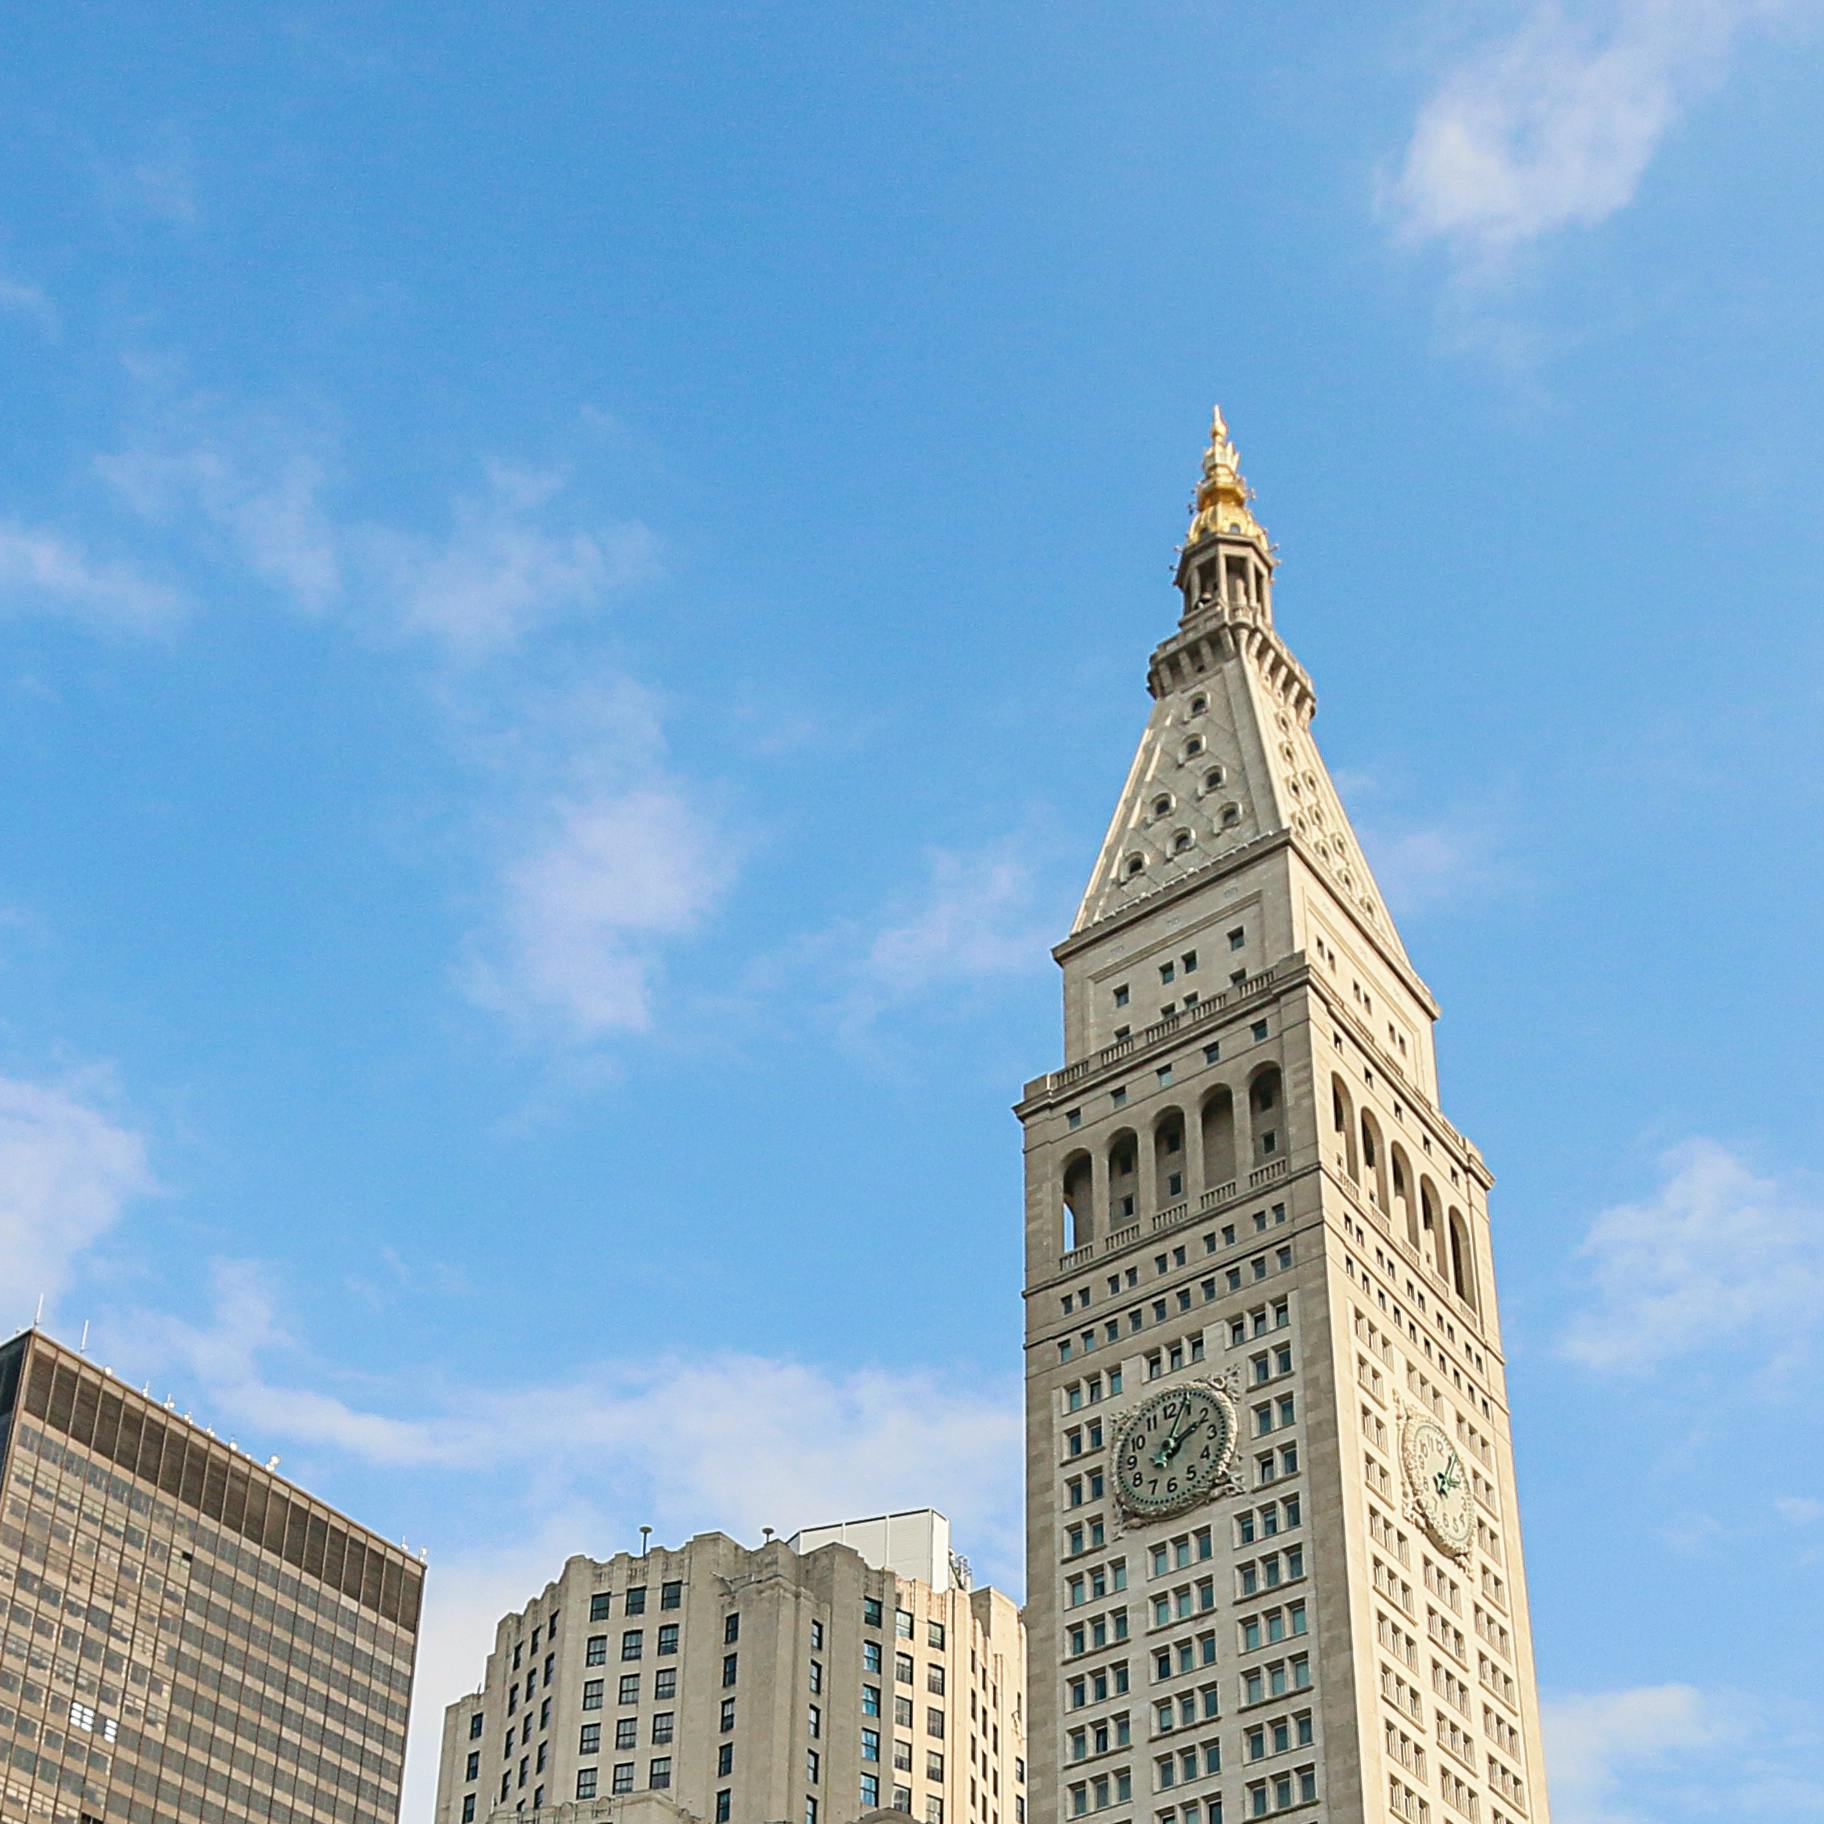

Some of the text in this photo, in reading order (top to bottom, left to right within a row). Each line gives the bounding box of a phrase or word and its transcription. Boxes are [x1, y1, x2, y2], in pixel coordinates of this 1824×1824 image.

[1163, 1402, 1177, 1420] 12
[1199, 1407, 1210, 1424] 2
[1146, 1414, 1158, 1432] 11
[1206, 1424, 1218, 1440] 3
[1131, 1434, 1146, 1452] 10
[1199, 1445, 1211, 1460] 4
[1127, 1455, 1138, 1471] 9
[1132, 1472, 1144, 1488] 8
[1186, 1465, 1198, 1481] 5
[1148, 1479, 1159, 1496] 7
[1166, 1477, 1178, 1493] 6
